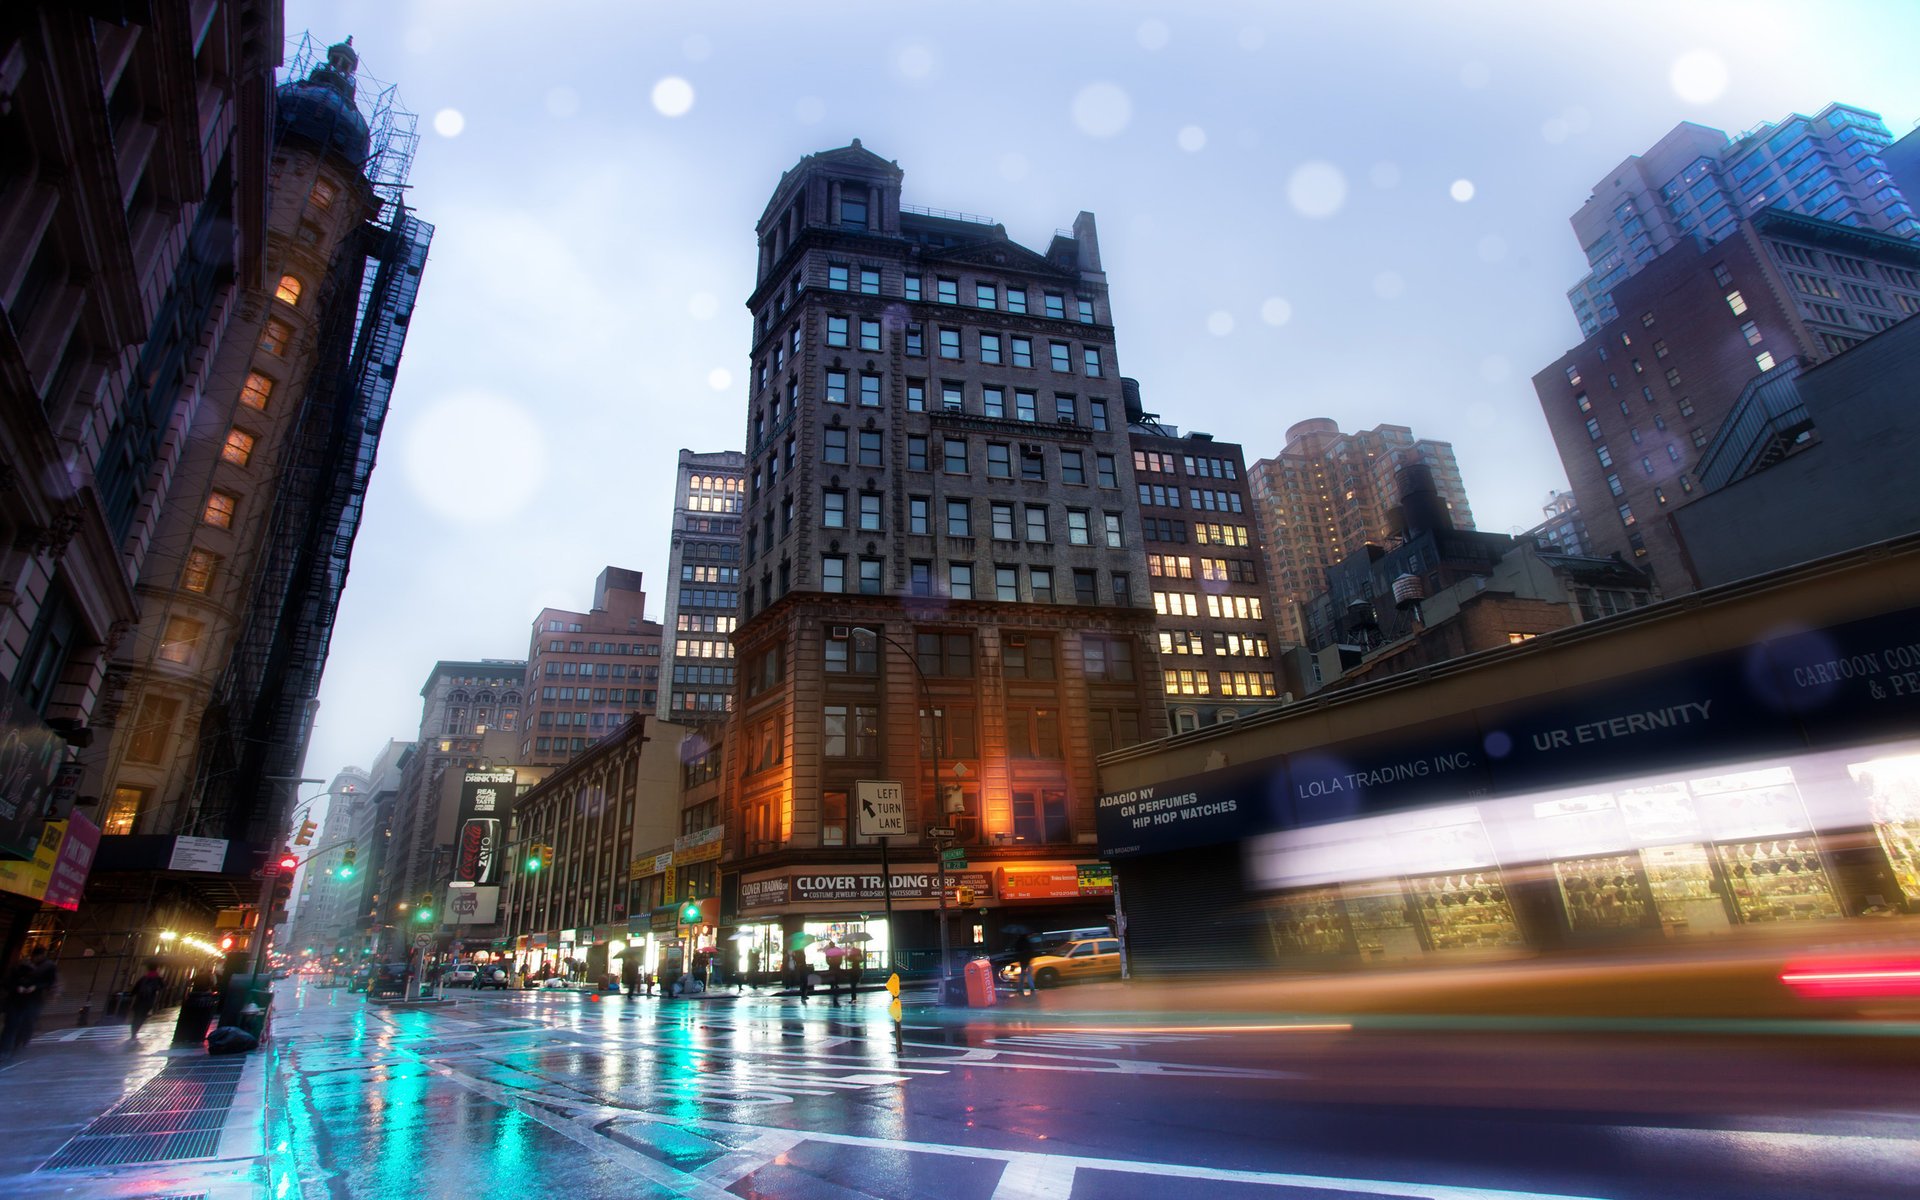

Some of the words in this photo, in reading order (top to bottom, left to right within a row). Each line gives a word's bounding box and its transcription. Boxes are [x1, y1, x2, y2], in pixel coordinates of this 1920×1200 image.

[1793, 652, 1881, 688] CARTOON
[1868, 679, 1887, 700] &
[1888, 671, 1920, 696] PE
[1532, 730, 1572, 751] UR
[1575, 698, 1712, 744] ETERNITY
[465, 775, 490, 783] DRINK
[490, 775, 513, 783] THEM
[1299, 777, 1344, 799] LOLA
[1345, 759, 1430, 790] TRADING
[1433, 751, 1477, 773] INC.
[877, 788, 898, 799] LEFT
[1100, 792, 1137, 808] ADAGIO
[1140, 788, 1154, 800] NY
[878, 803, 901, 813] TURN
[1120, 805, 1136, 817] GN
[1140, 793, 1198, 814] PERFUMES
[879, 818, 901, 829] LANE
[1132, 817, 1151, 829] HIP
[1154, 811, 1178, 825] HOP
[1180, 800, 1237, 820] WATCHES
[478, 837, 491, 867] zero
[1114, 844, 1141, 854] BROADWAY
[742, 883, 760, 896] CLOVER
[761, 879, 782, 893] TRADING
[796, 876, 856, 890] CLOVER
[859, 875, 928, 889] TRADING
[809, 891, 834, 899] COSTUME
[834, 891, 857, 899] JEWELRY
[892, 889, 922, 897] ACCESSORIES
